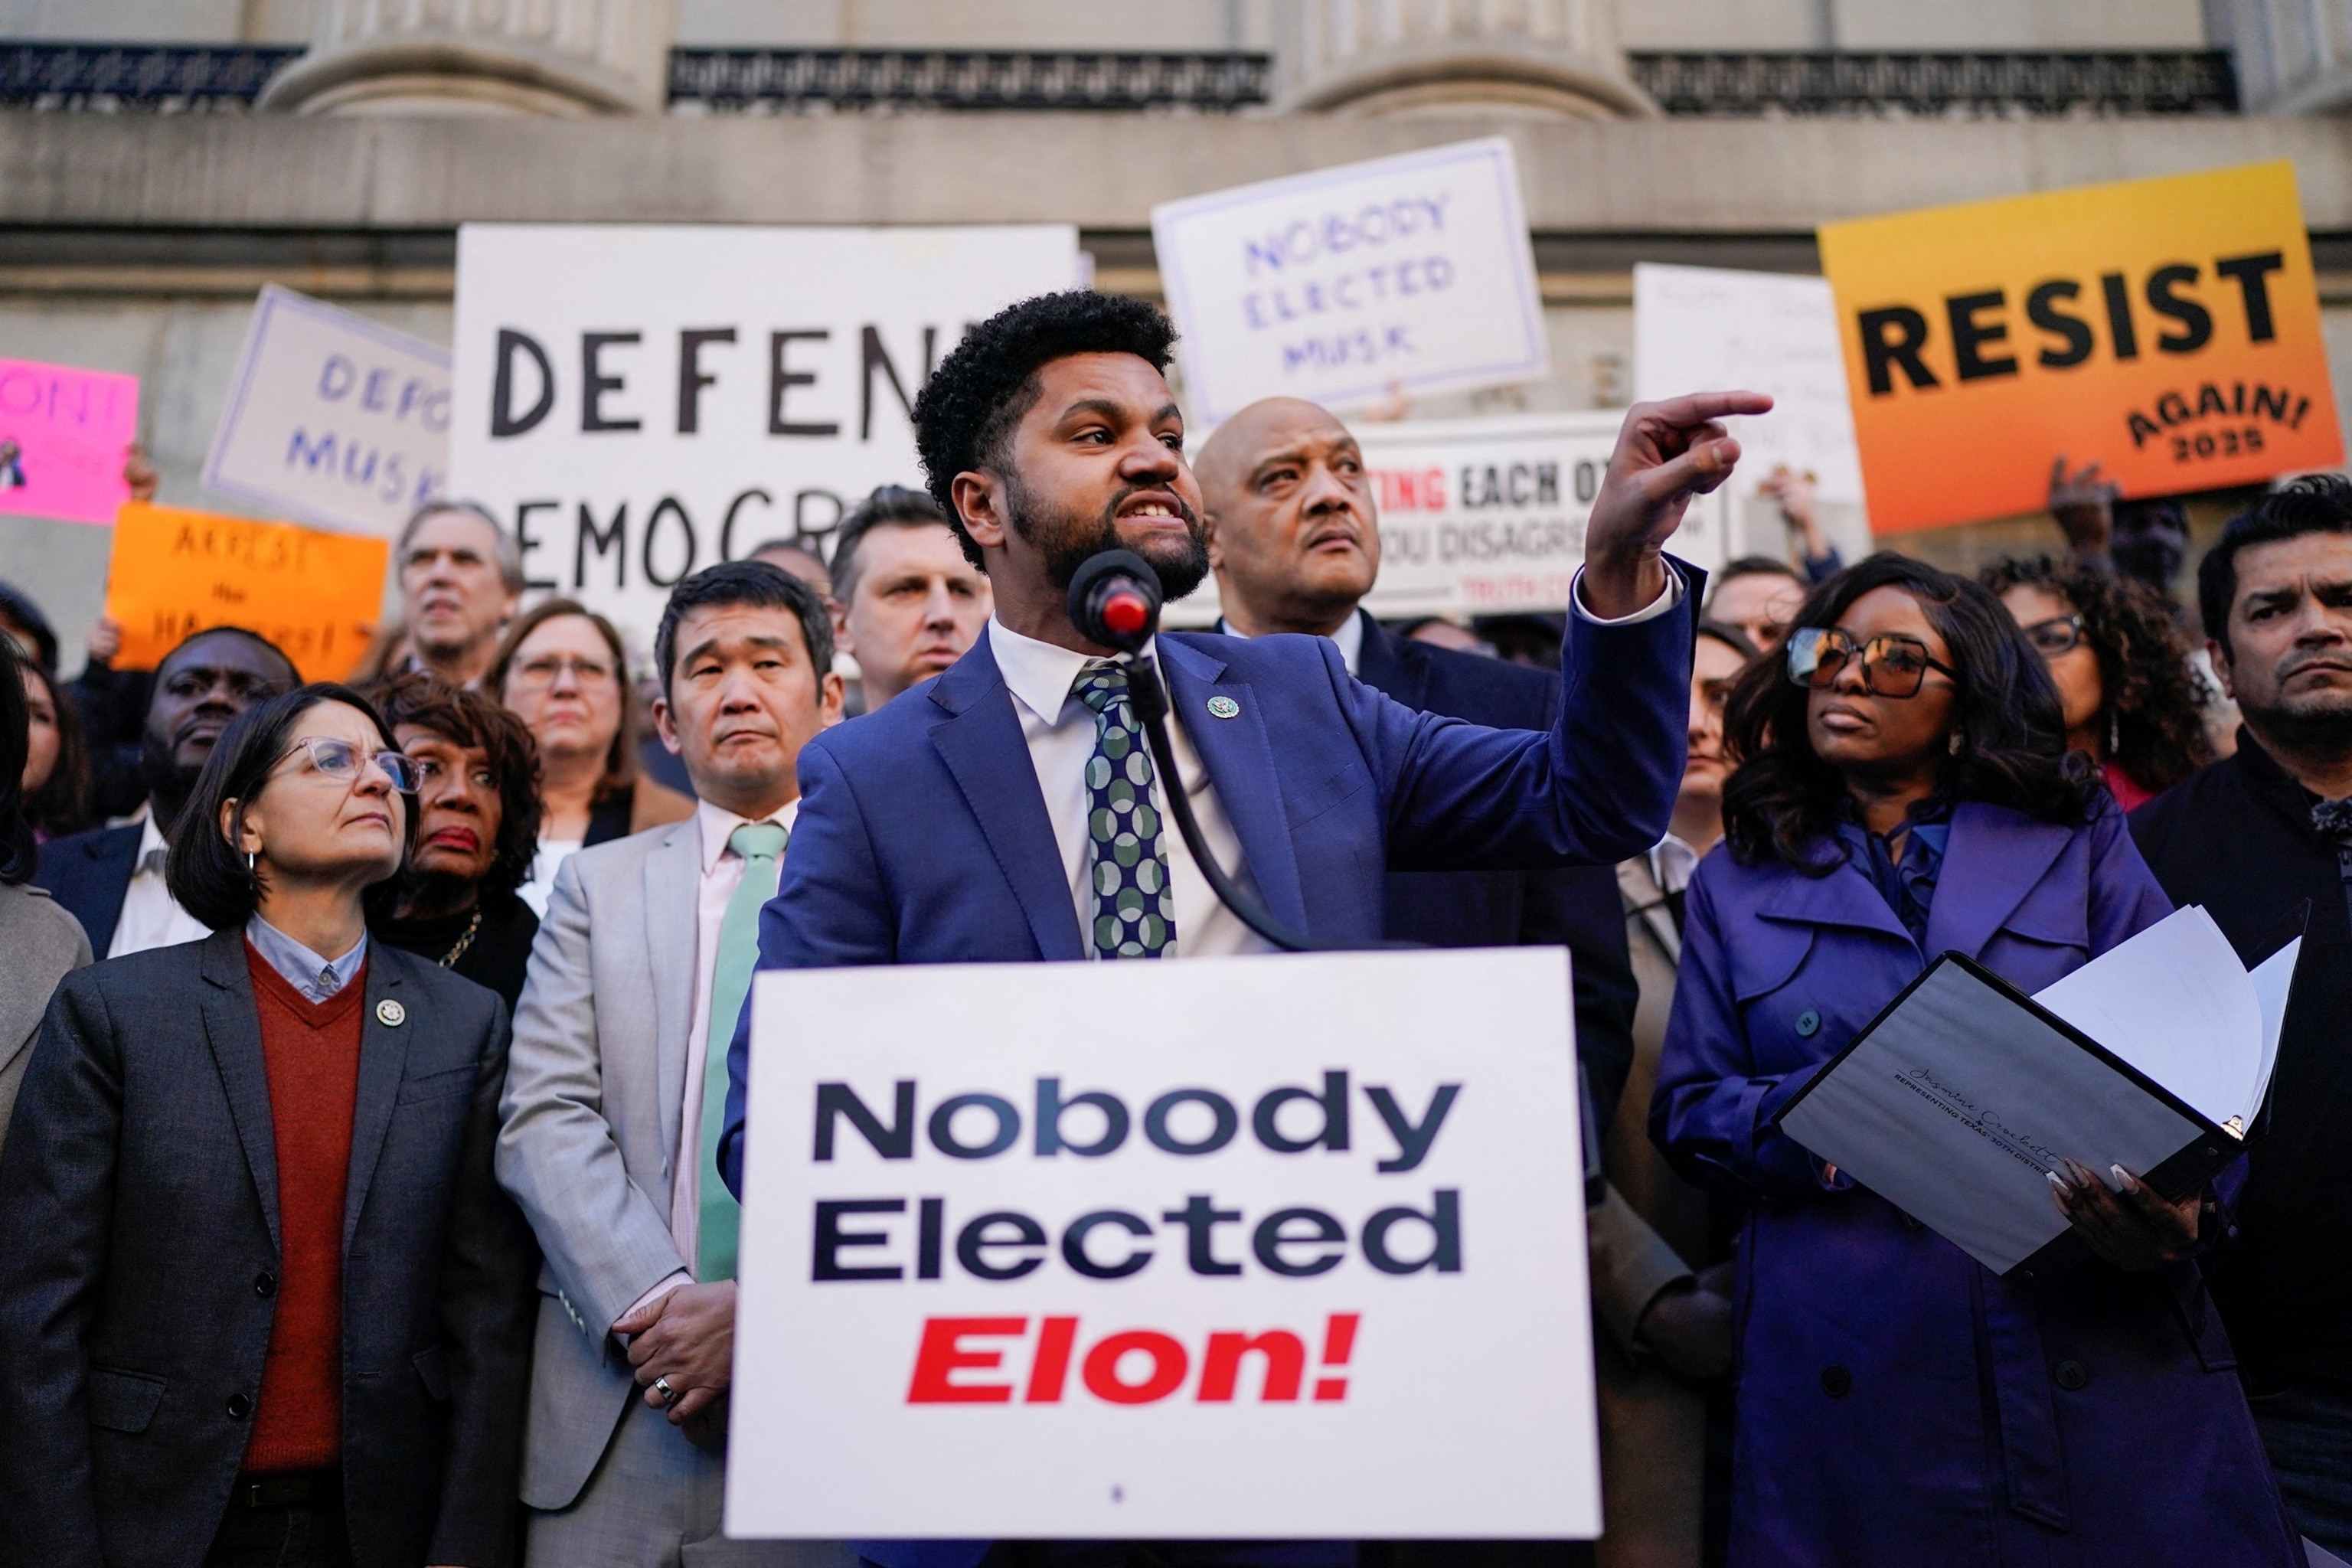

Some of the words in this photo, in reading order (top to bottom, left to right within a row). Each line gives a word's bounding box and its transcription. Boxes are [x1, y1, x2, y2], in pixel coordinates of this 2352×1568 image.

[1243, 191, 1450, 276] NOBODY
[1243, 256, 1455, 329] ELECTED
[1858, 251, 2285, 397] RESIST
[491, 325, 983, 440] DEFEN
[1282, 328, 1417, 372] MUSK
[2128, 383, 2310, 447] AGAIN!
[2173, 427, 2262, 463] 2025
[1365, 466, 1446, 513] ING
[1461, 462, 1559, 508] EACH
[812, 1070, 1462, 1173] Nobody
[1894, 1074, 1958, 1119] REPRESENTING
[1990, 1137, 2014, 1155] 30TH
[1909, 1069, 1976, 1111] Jasmine
[1981, 1111, 2063, 1163] Crockett
[811, 1189, 1462, 1282] Elected
[905, 1312, 1361, 1405] Elon!
